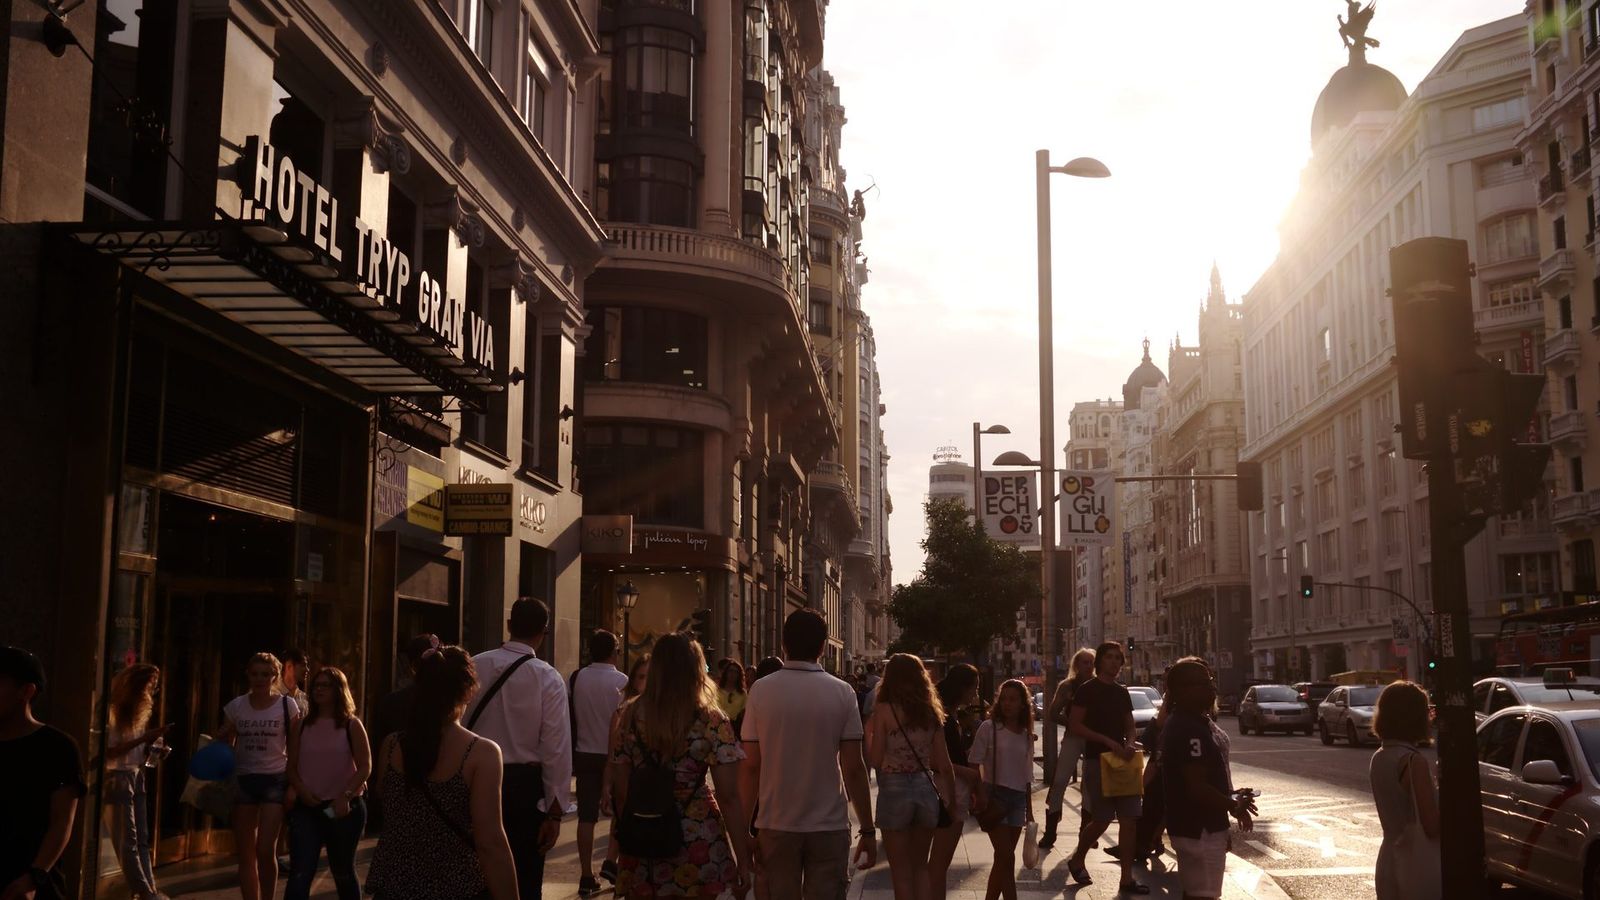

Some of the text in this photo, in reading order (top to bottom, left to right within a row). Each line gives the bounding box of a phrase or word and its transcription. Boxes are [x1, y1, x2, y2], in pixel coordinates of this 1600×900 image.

[254, 136, 495, 371] HOTEL TRYP GRAN VIA
[985, 476, 1027, 496] DER
[1063, 476, 1095, 495] OR
[520, 494, 546, 525] KIKO
[986, 496, 1030, 515] ECH
[1073, 496, 1105, 515] GU
[587, 527, 625, 539] KIKO
[999, 515, 1032, 534] OS
[1068, 515, 1110, 534] LLO
[1190, 738, 1201, 757] 3
